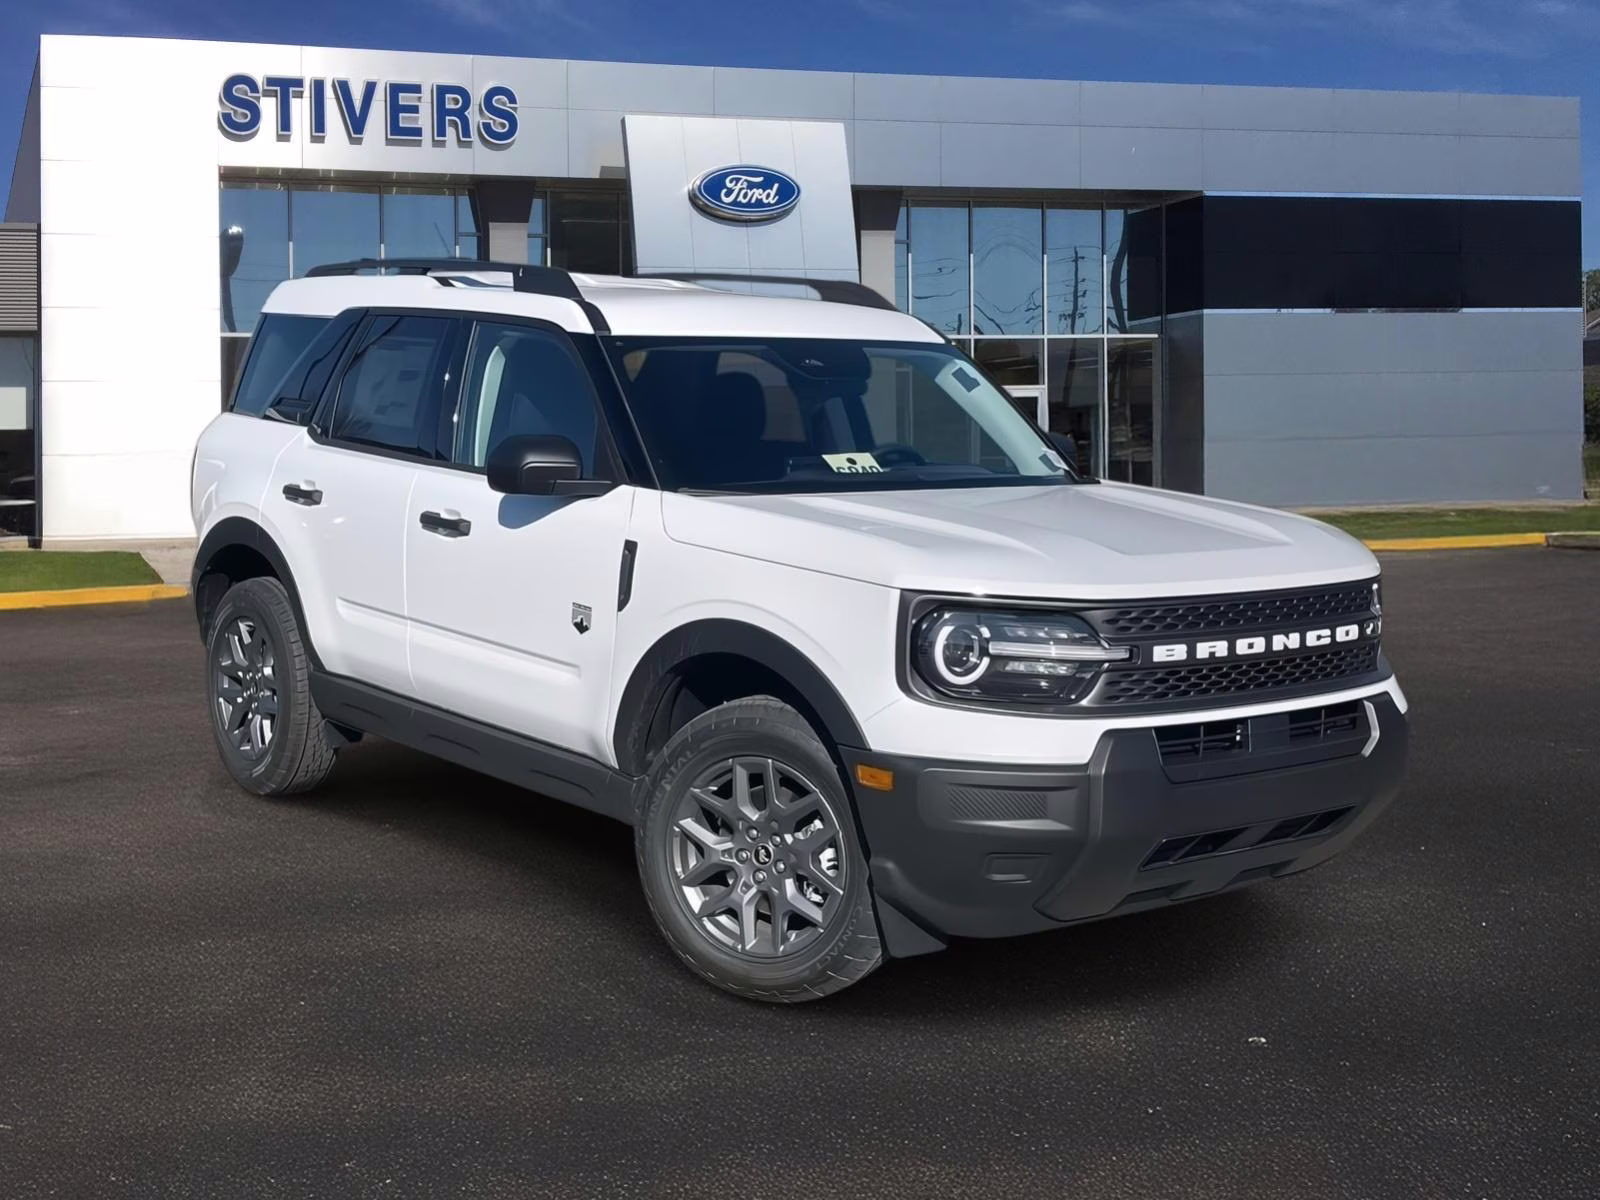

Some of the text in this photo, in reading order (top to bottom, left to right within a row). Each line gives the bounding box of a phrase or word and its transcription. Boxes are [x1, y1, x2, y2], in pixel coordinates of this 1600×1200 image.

[218, 73, 519, 146] STIVERS
[723, 175, 779, 205] Ford
[1152, 624, 1359, 662] BRONCO
